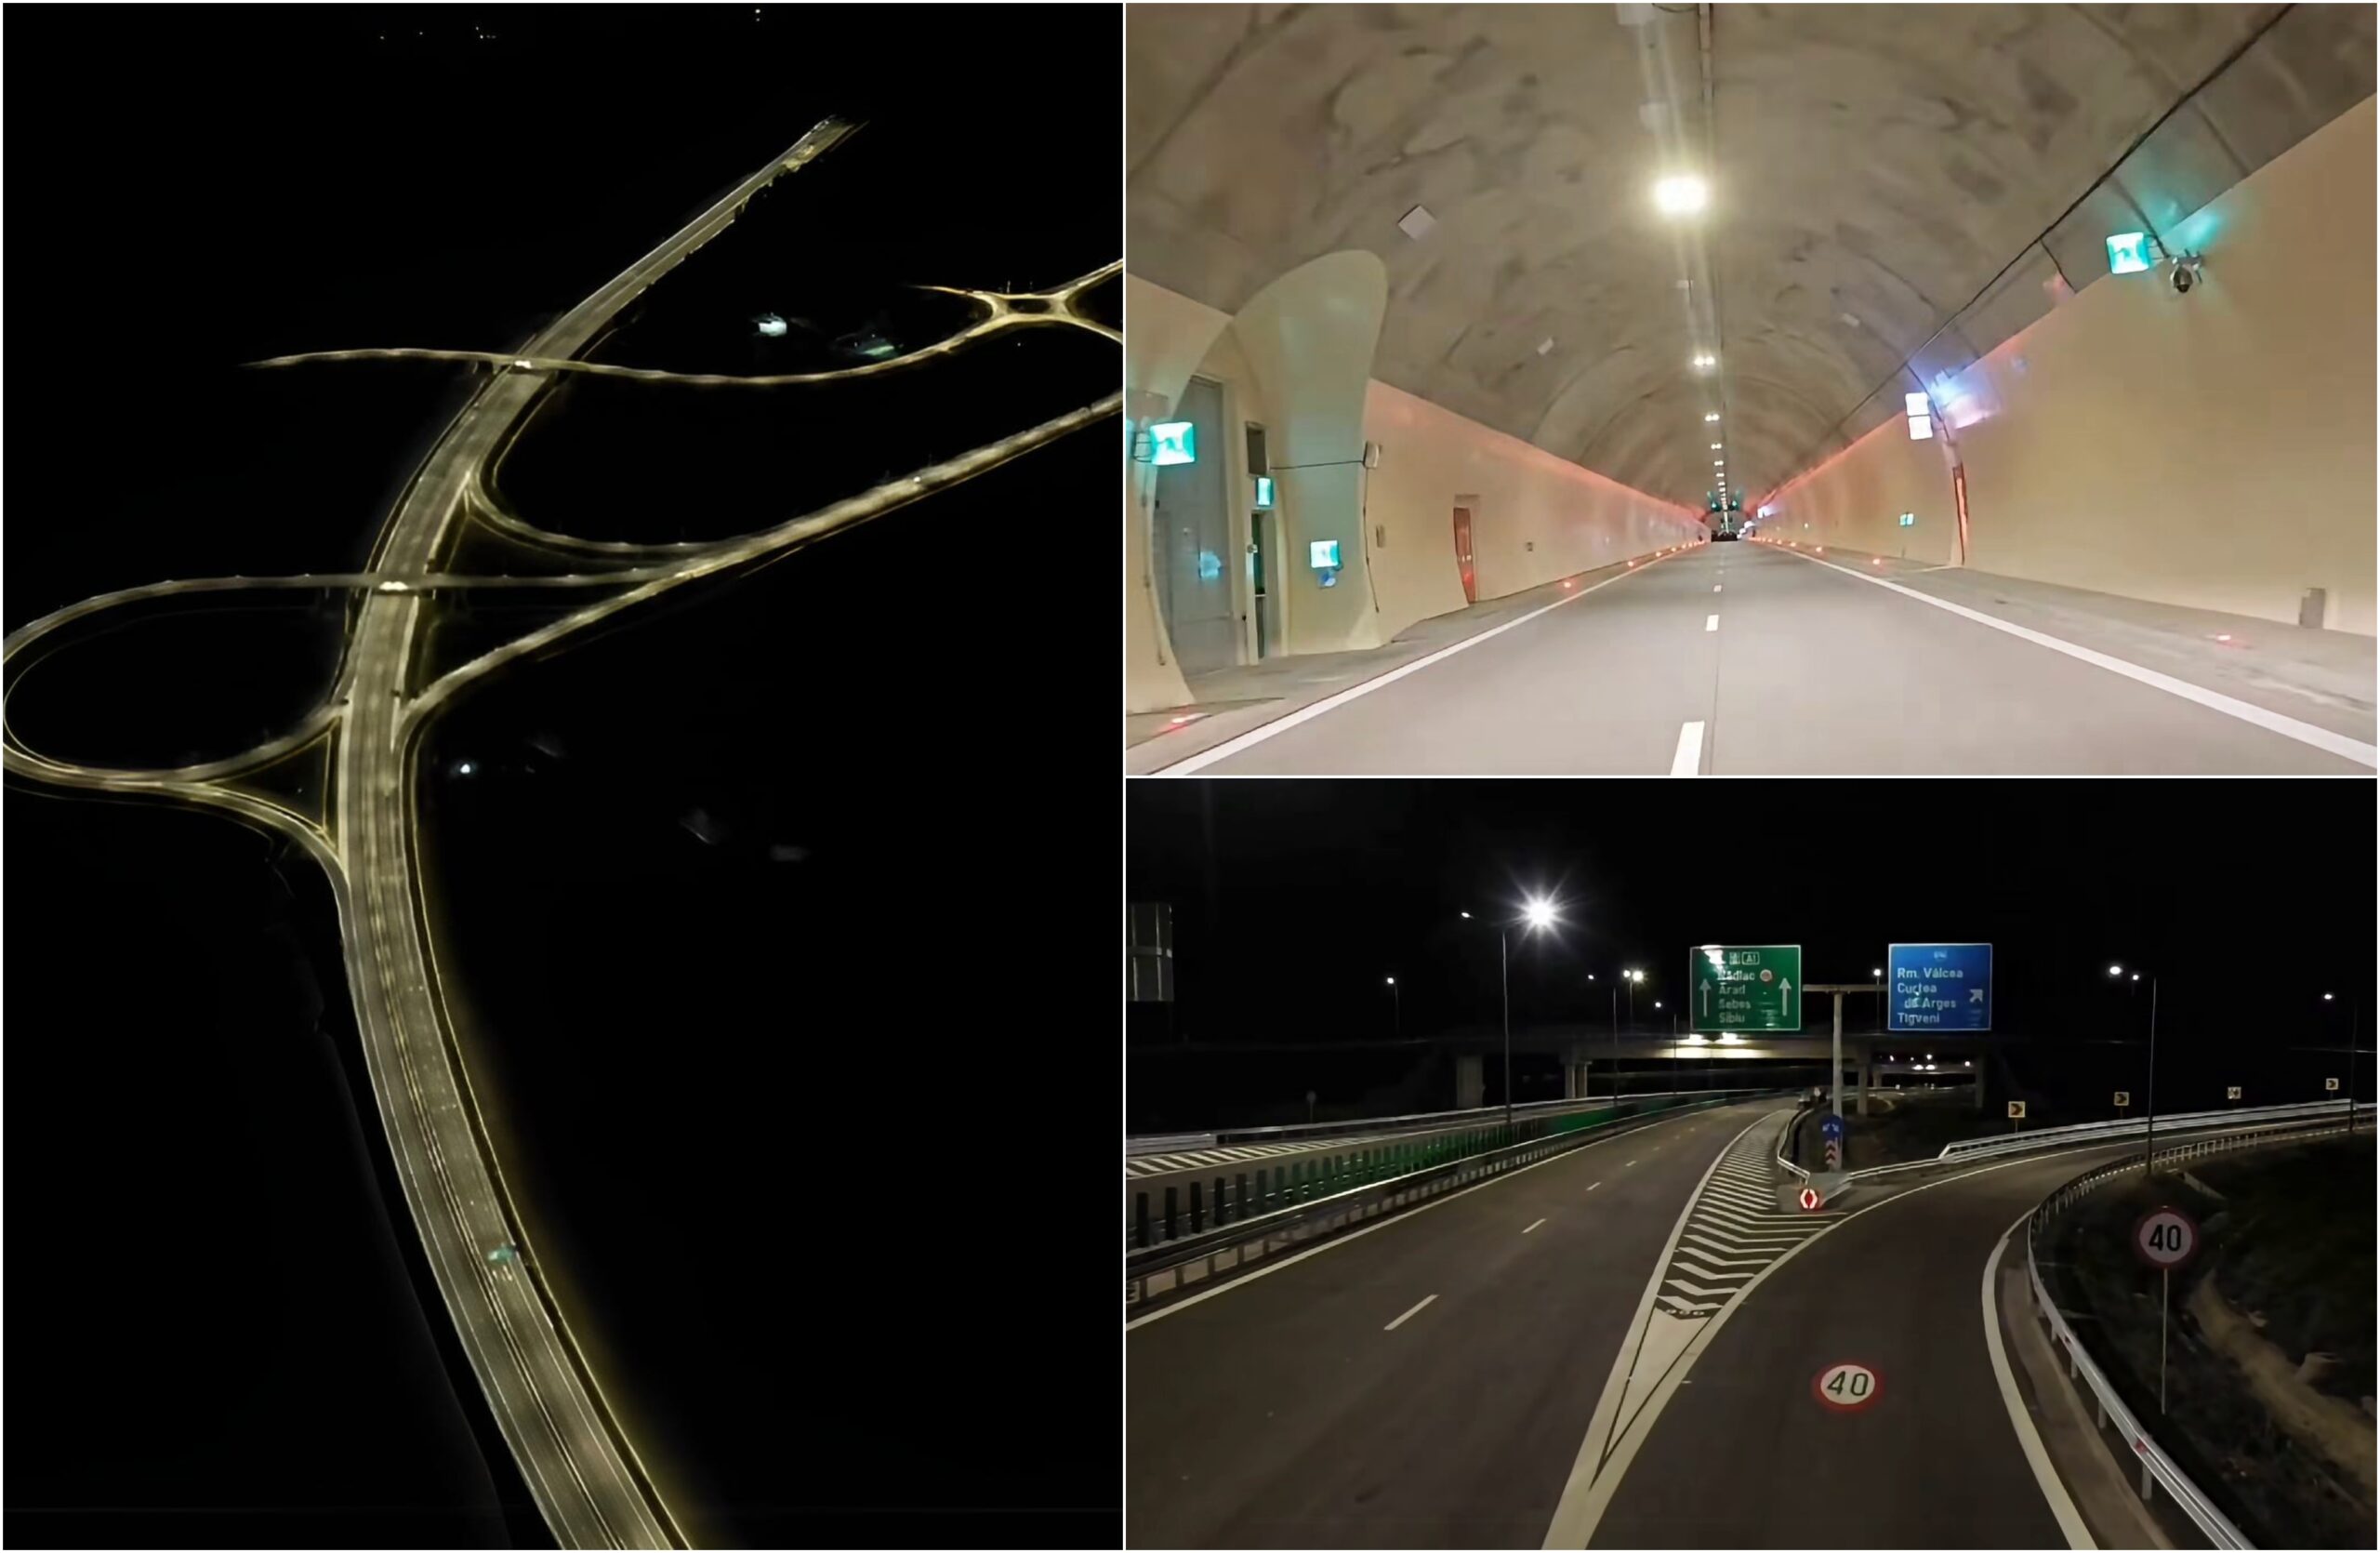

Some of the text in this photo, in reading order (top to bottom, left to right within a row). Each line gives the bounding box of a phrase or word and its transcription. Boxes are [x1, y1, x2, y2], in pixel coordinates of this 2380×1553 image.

[1718, 984, 1746, 995] Arad
[1719, 1011, 1745, 1024] Sibiu
[1897, 1012, 1940, 1027] Tigveni
[2149, 1224, 2182, 1252] 40
[1827, 1371, 1869, 1397] 40
